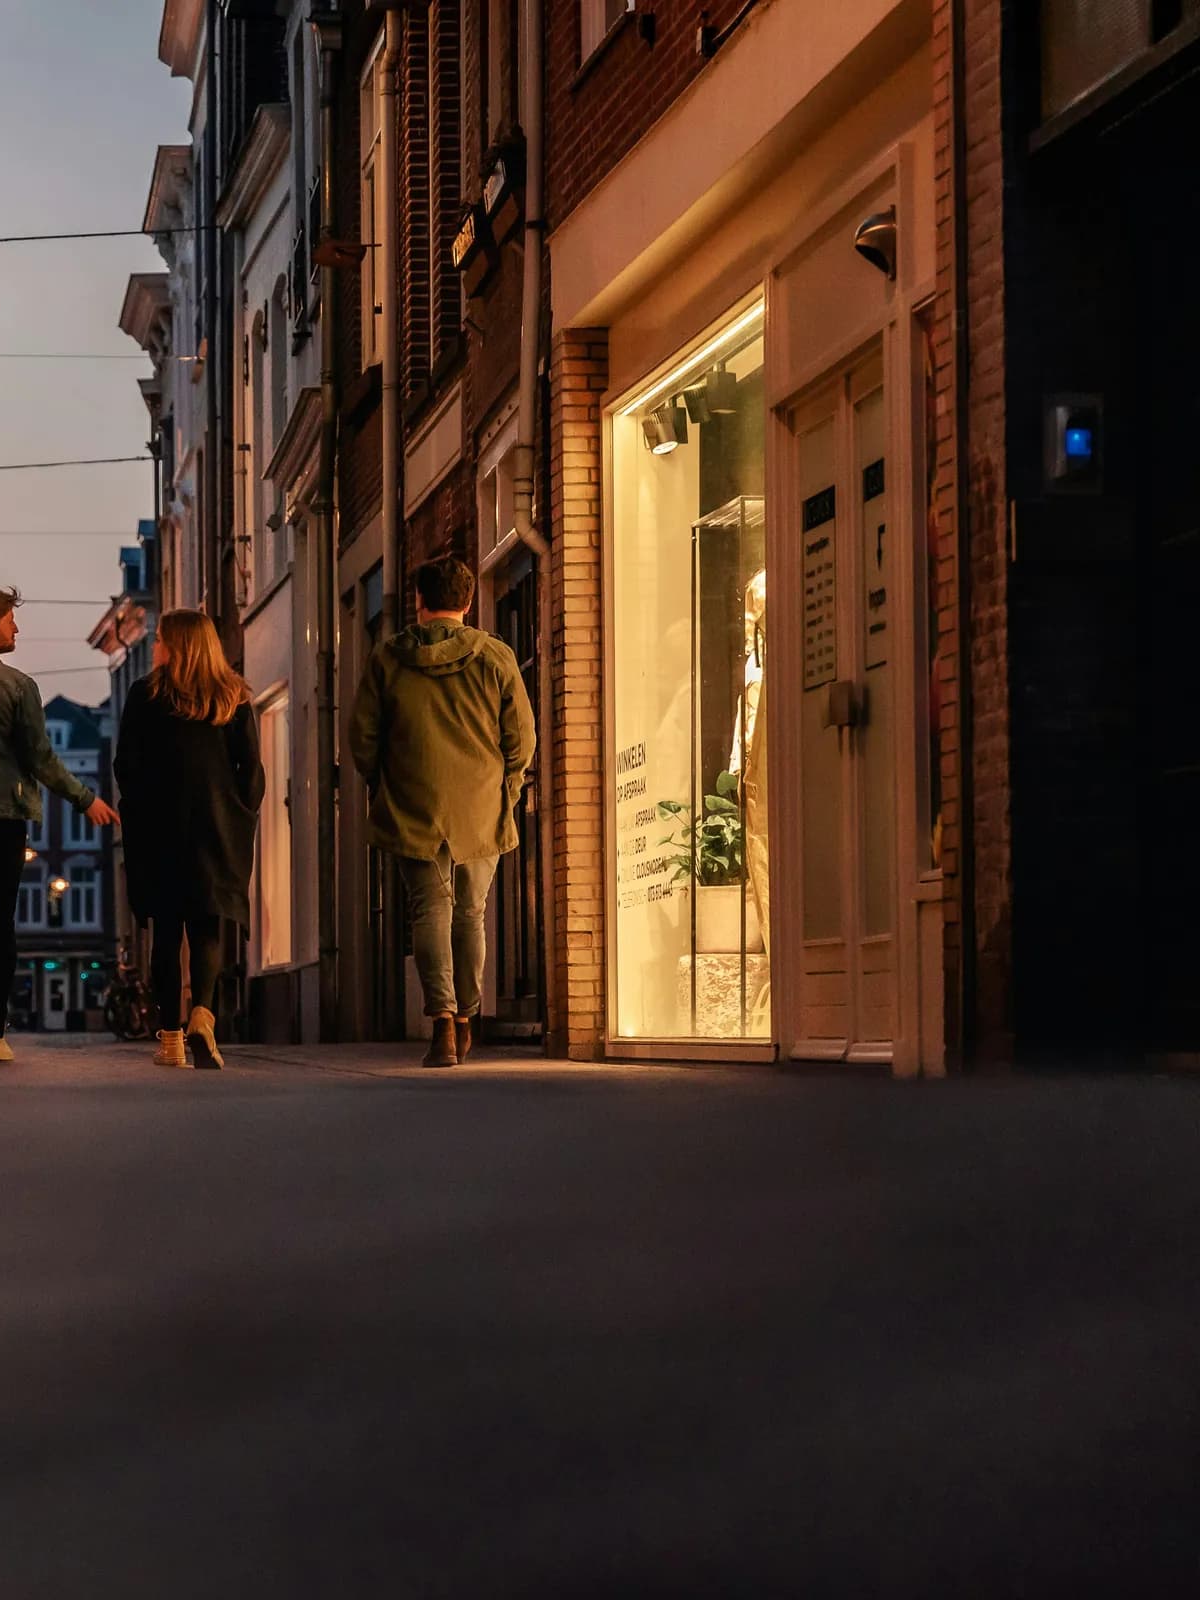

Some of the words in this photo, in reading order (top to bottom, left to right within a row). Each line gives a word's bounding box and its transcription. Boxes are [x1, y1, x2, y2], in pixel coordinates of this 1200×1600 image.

[616, 740, 646, 775] WINKELEN
[623, 776, 647, 801] AFSPRAAK
[635, 807, 657, 828] AFSPRAAK
[635, 836, 647, 854] DEUR
